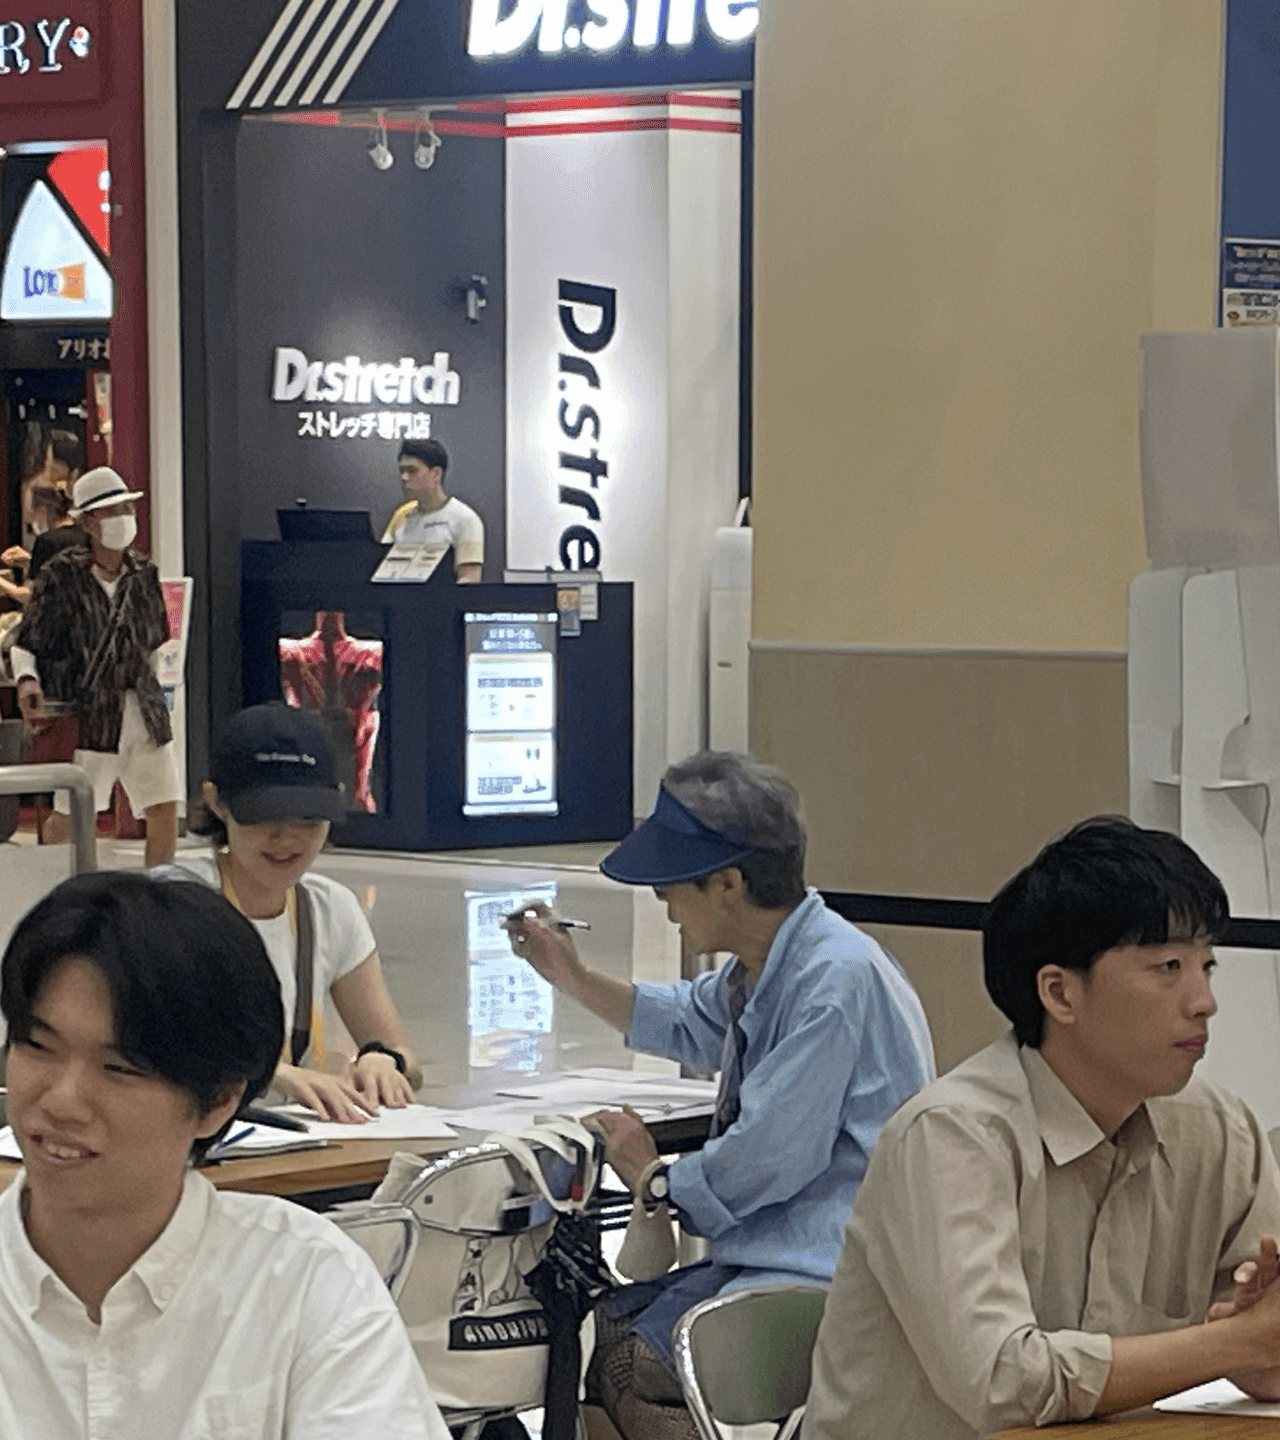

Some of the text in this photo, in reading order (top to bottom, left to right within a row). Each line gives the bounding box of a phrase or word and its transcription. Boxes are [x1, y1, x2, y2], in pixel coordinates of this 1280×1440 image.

[273, 347, 460, 404] Dr.stretch
[298, 410, 431, 439] ストレッチ専門店
